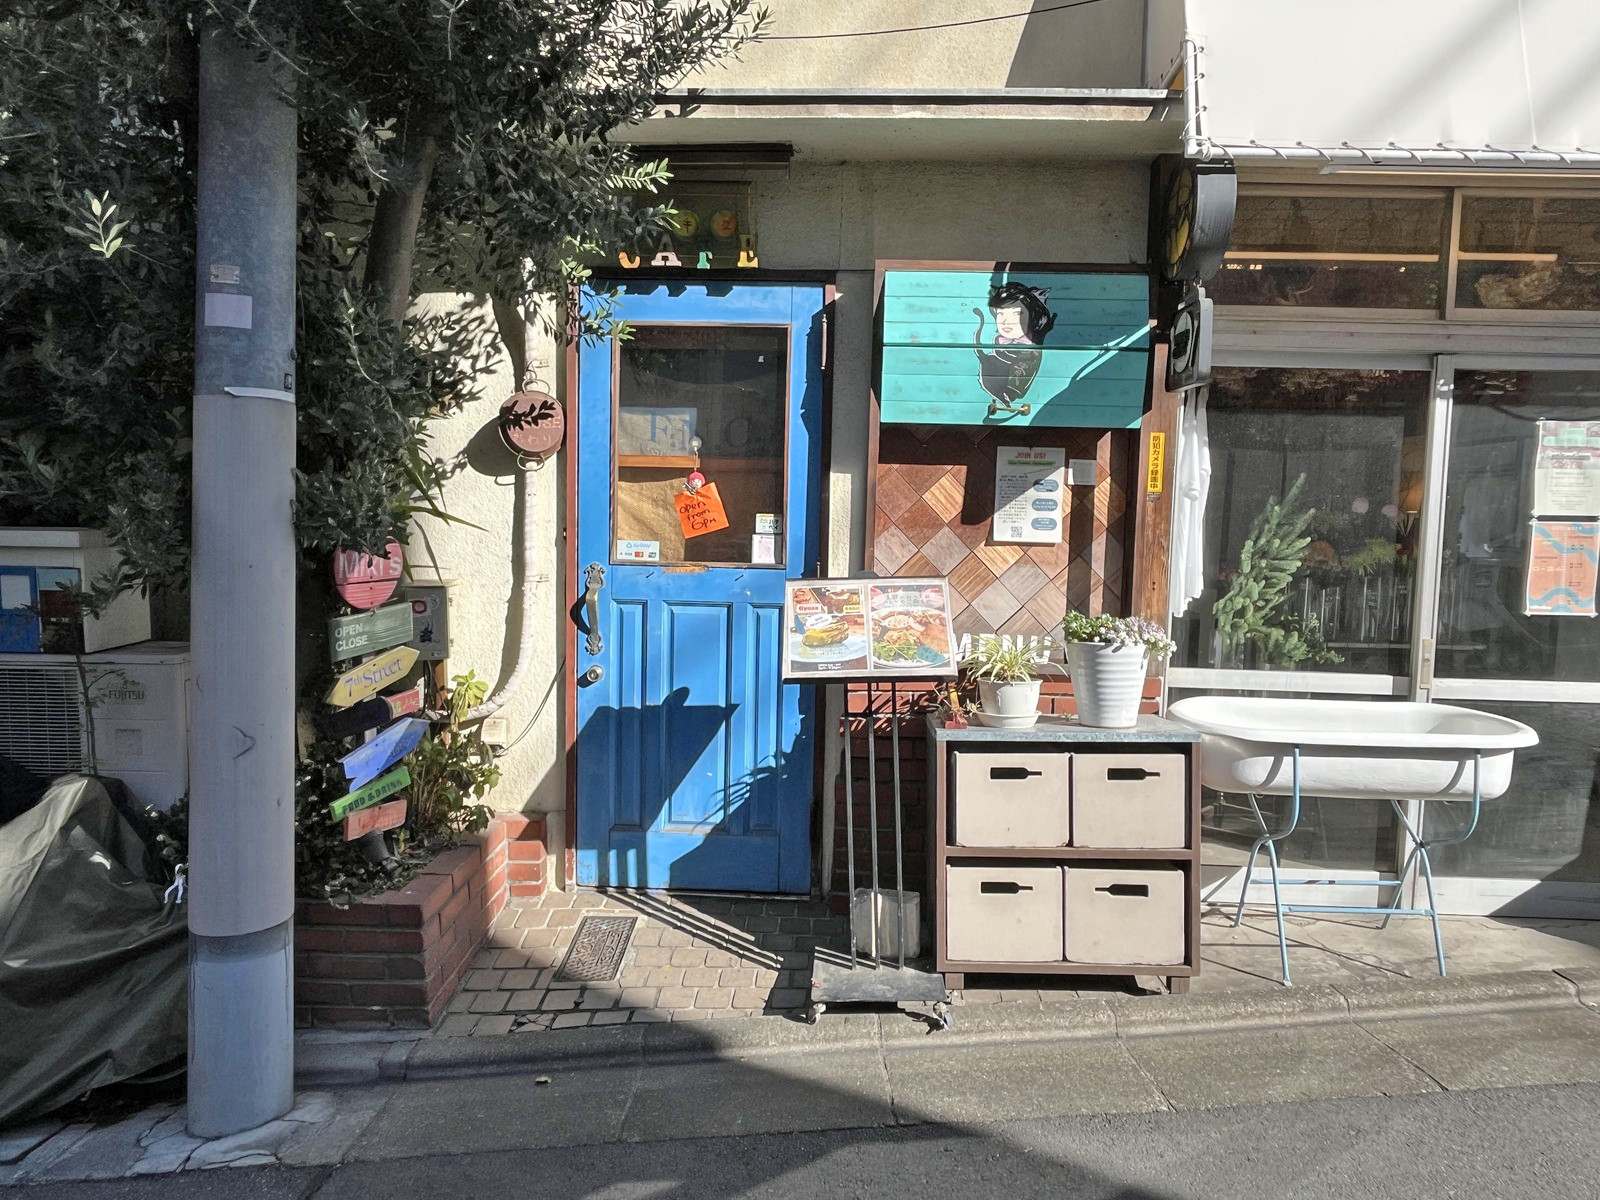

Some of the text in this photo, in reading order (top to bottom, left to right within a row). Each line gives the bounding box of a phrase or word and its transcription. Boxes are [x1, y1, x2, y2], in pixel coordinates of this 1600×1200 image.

[1015, 451, 1031, 459] JOIN
[679, 500, 706, 515] open
[687, 508, 710, 522] from
[335, 623, 363, 638] OPEN
[335, 635, 368, 652] CLOSE
[345, 656, 403, 697] 7th Street
[108, 690, 145, 701] FUJITSU
